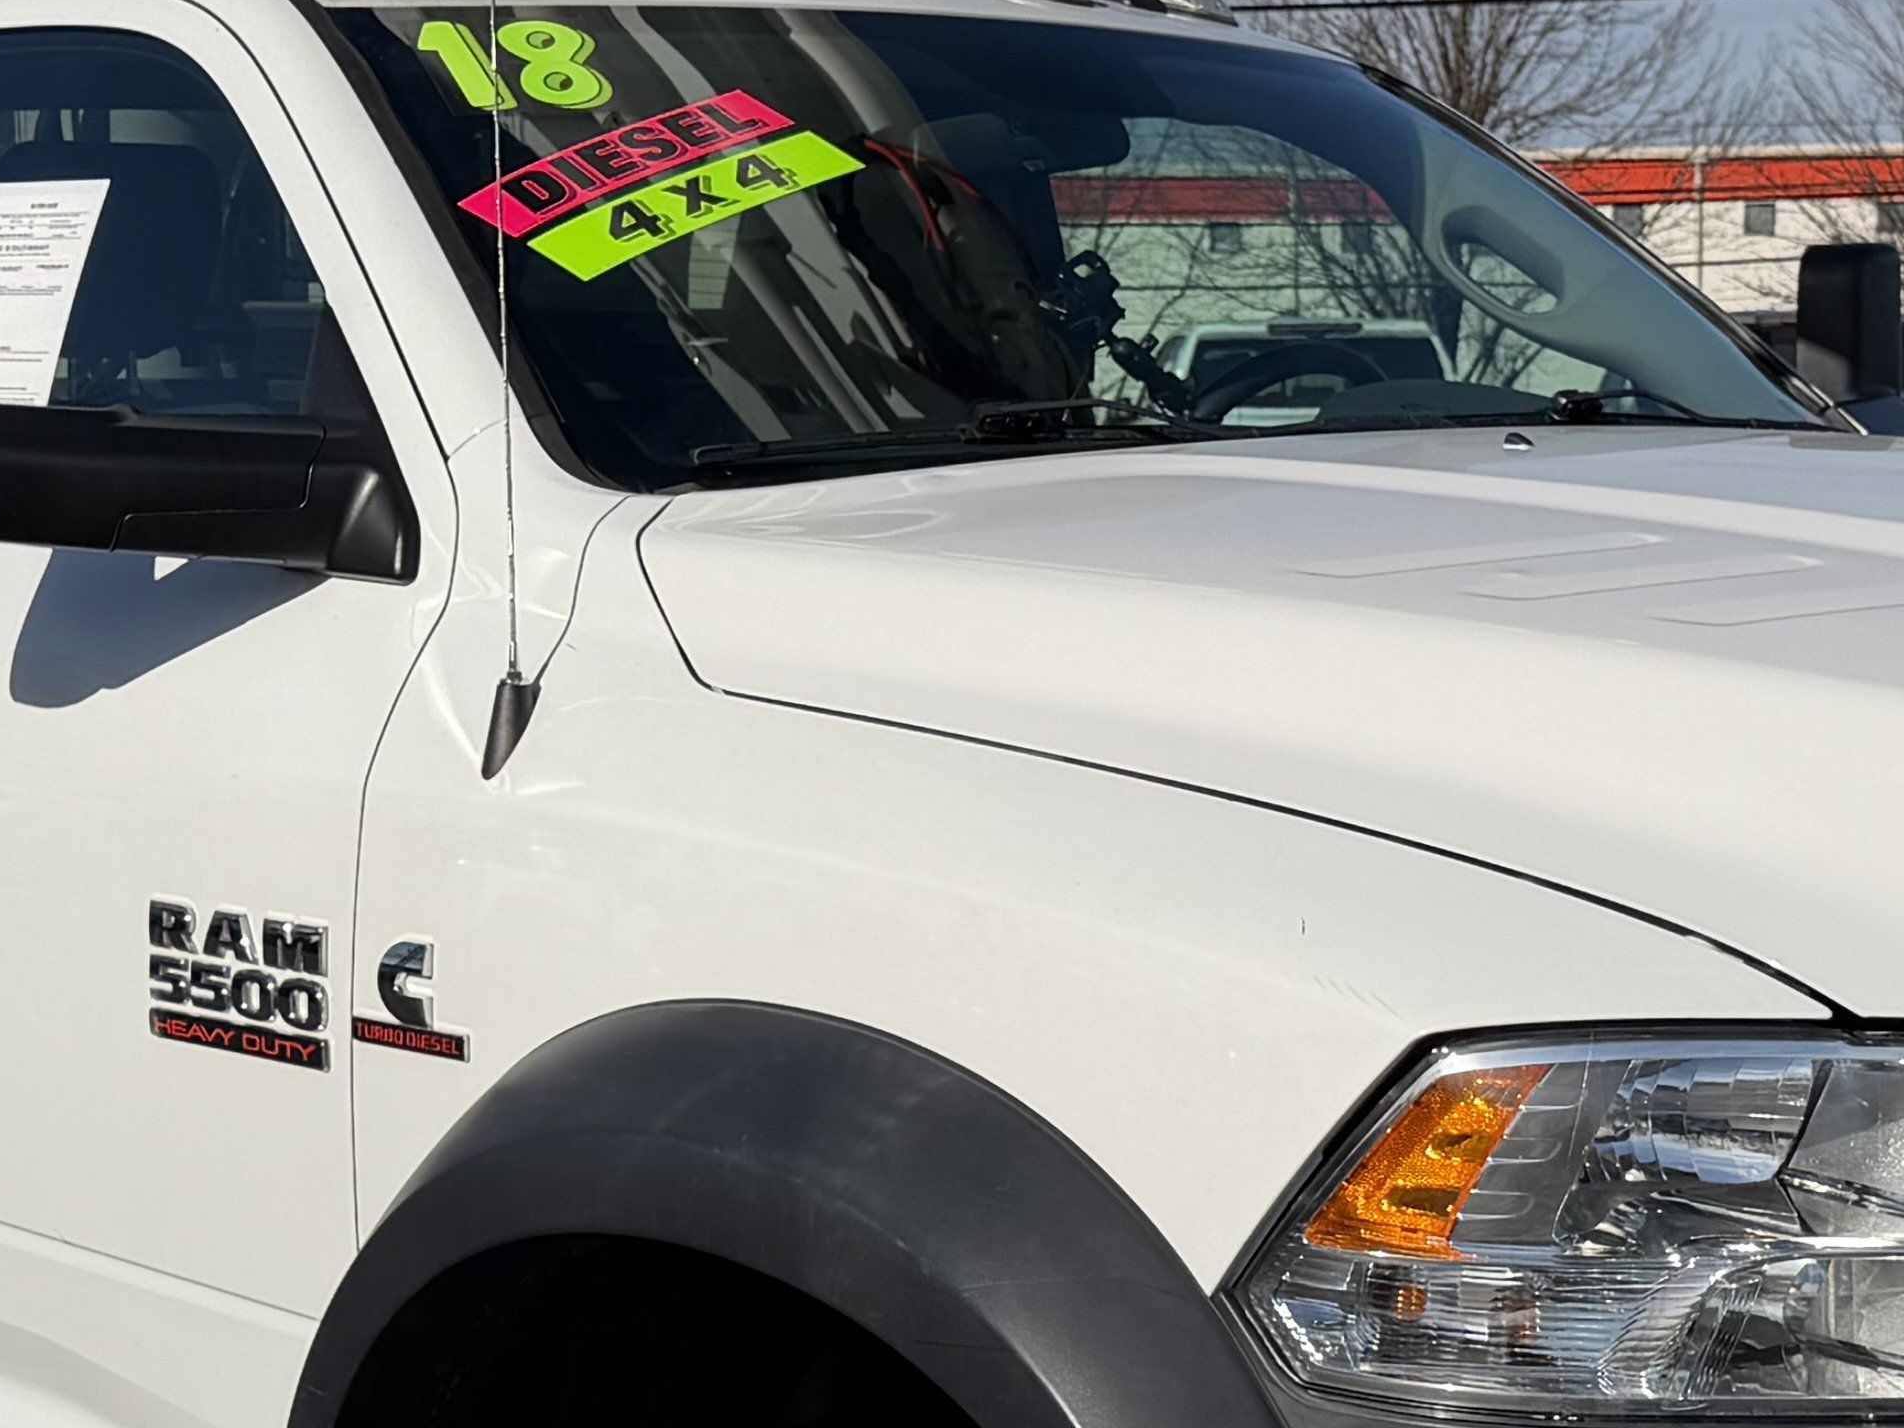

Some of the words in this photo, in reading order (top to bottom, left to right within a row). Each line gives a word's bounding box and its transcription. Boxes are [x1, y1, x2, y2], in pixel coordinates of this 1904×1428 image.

[417, 21, 613, 111] 18
[502, 103, 770, 221] DIESEL
[149, 899, 328, 978] RAM
[149, 954, 329, 1032] 5500
[154, 1016, 236, 1047] HEAVY
[242, 1033, 317, 1062] DUTY
[355, 1021, 405, 1046] TURBO
[405, 1031, 460, 1056] DIESEL
